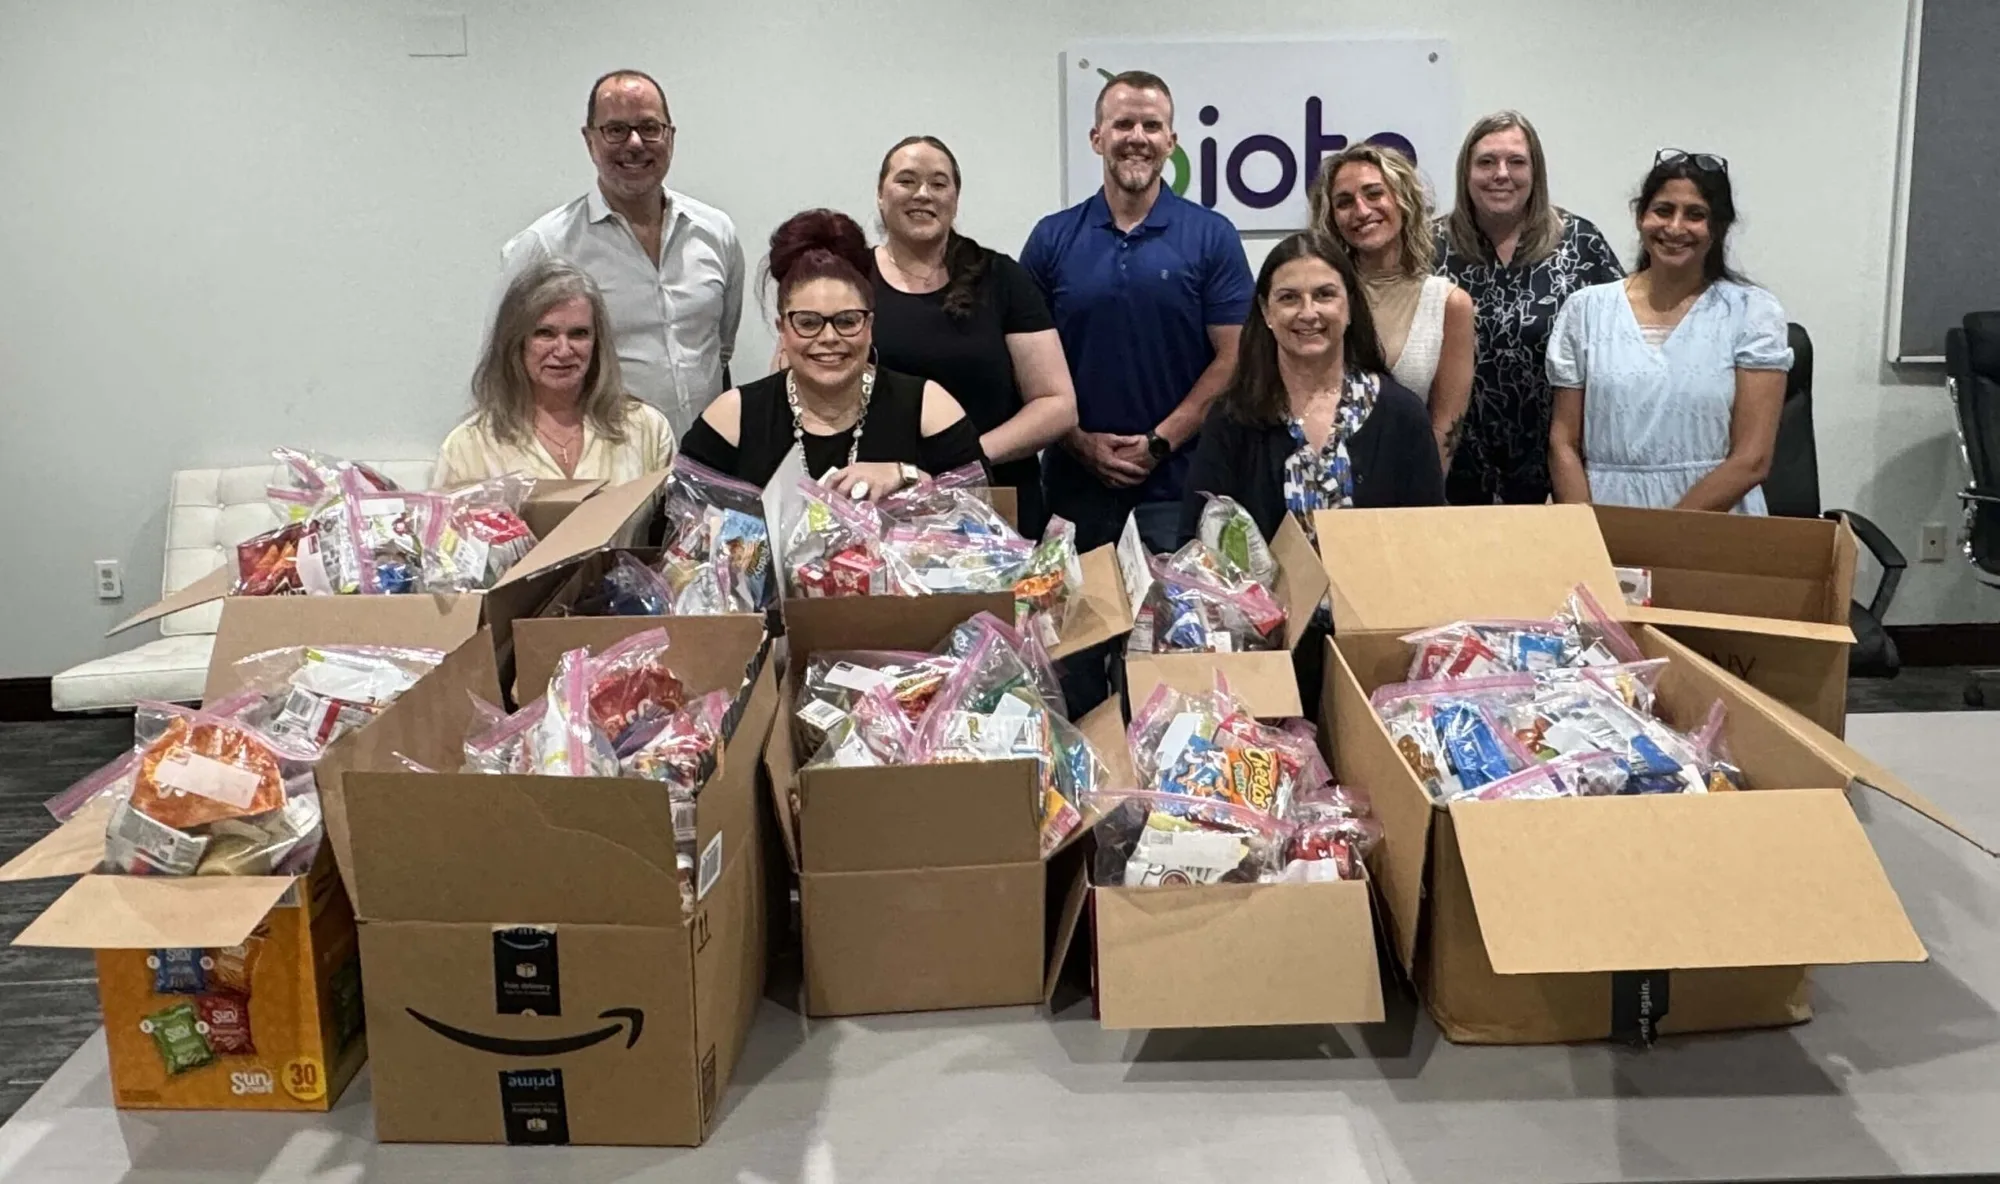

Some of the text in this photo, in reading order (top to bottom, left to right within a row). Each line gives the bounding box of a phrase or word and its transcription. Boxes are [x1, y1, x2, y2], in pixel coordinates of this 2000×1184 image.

[1244, 749, 1271, 808] Cheetos
[290, 1063, 317, 1086] 30
[507, 1073, 556, 1090] prime
